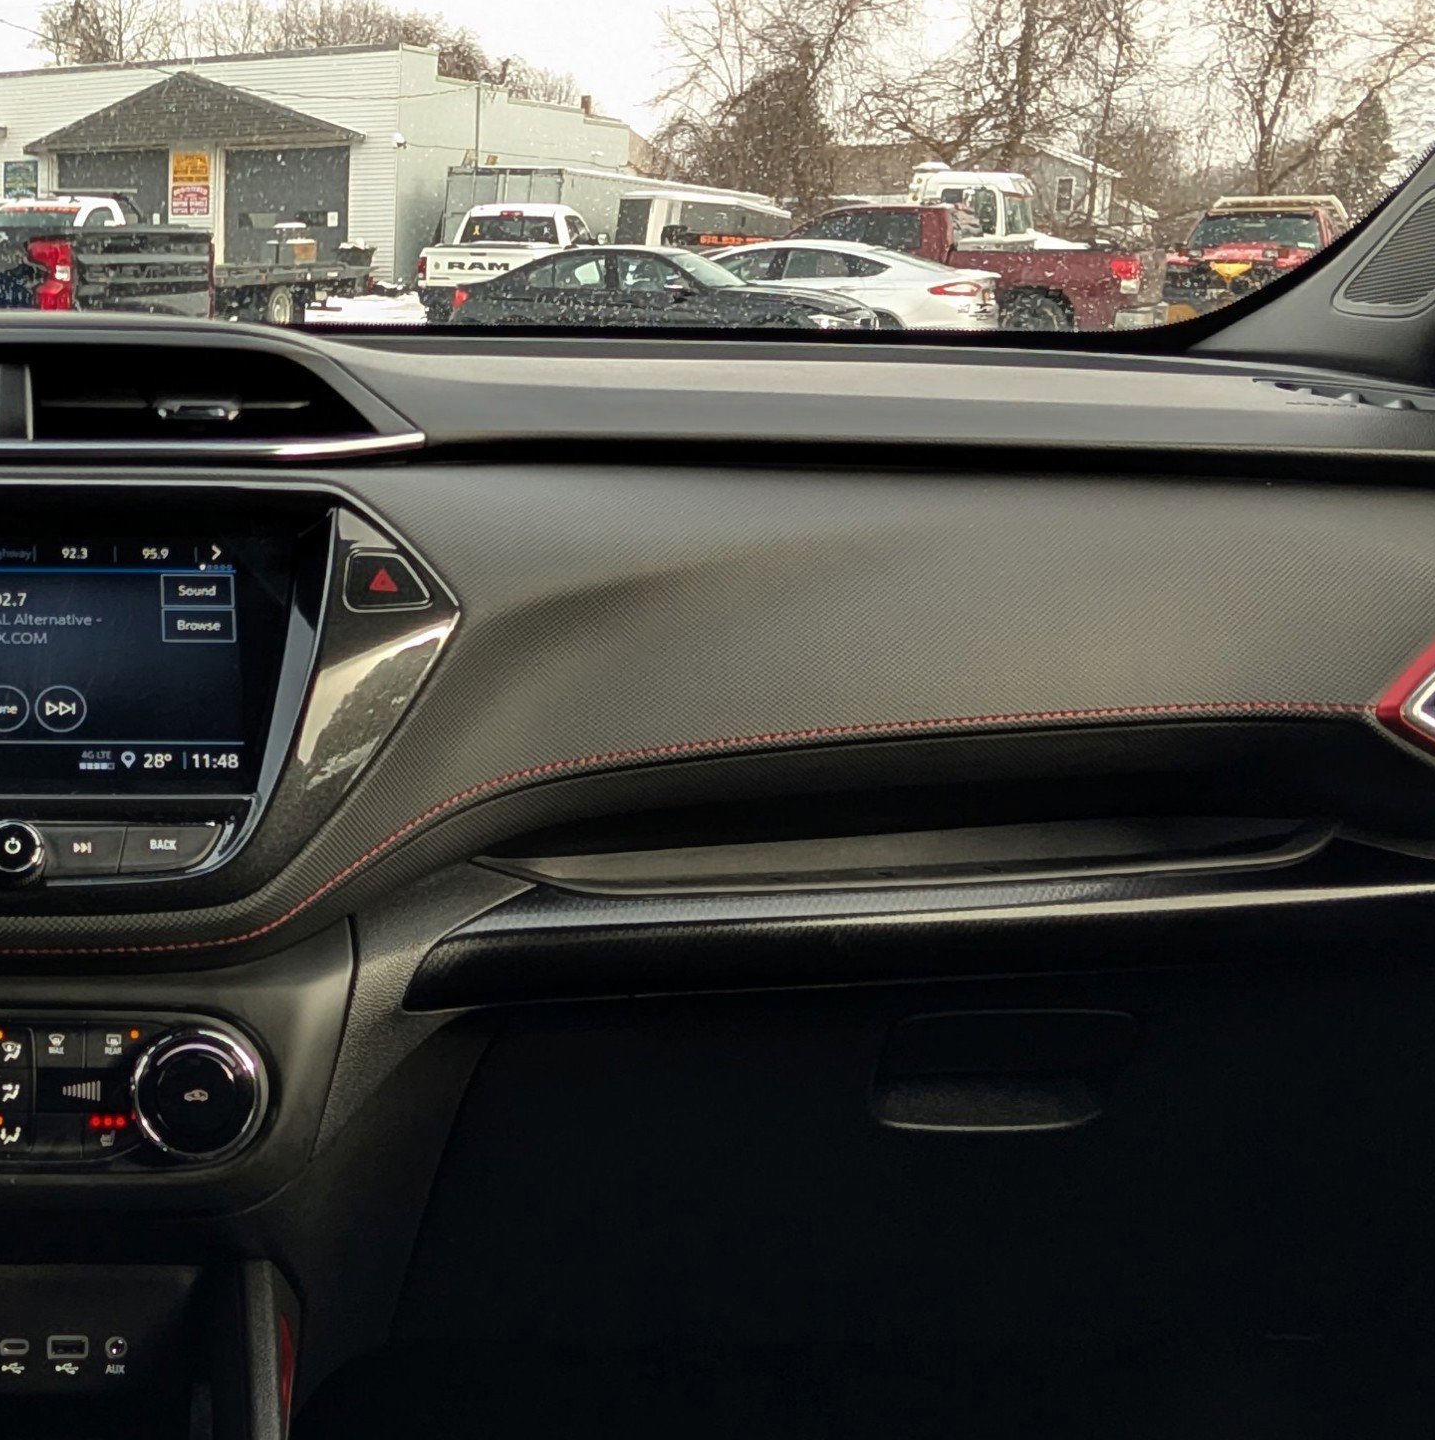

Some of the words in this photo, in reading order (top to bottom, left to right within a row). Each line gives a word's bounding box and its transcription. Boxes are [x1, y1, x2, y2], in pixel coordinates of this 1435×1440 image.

[447, 261, 510, 271] RAM
[61, 547, 89, 560] 92.3
[141, 548, 170, 560] 95.9
[178, 585, 217, 597] Sound
[14, 613, 92, 626] Alternative
[177, 620, 221, 632] Browse
[81, 750, 96, 761] 4G
[96, 750, 112, 761] LTE
[192, 753, 240, 770] 11:48
[150, 838, 177, 851] BACK
[105, 1364, 125, 1375] AUX
